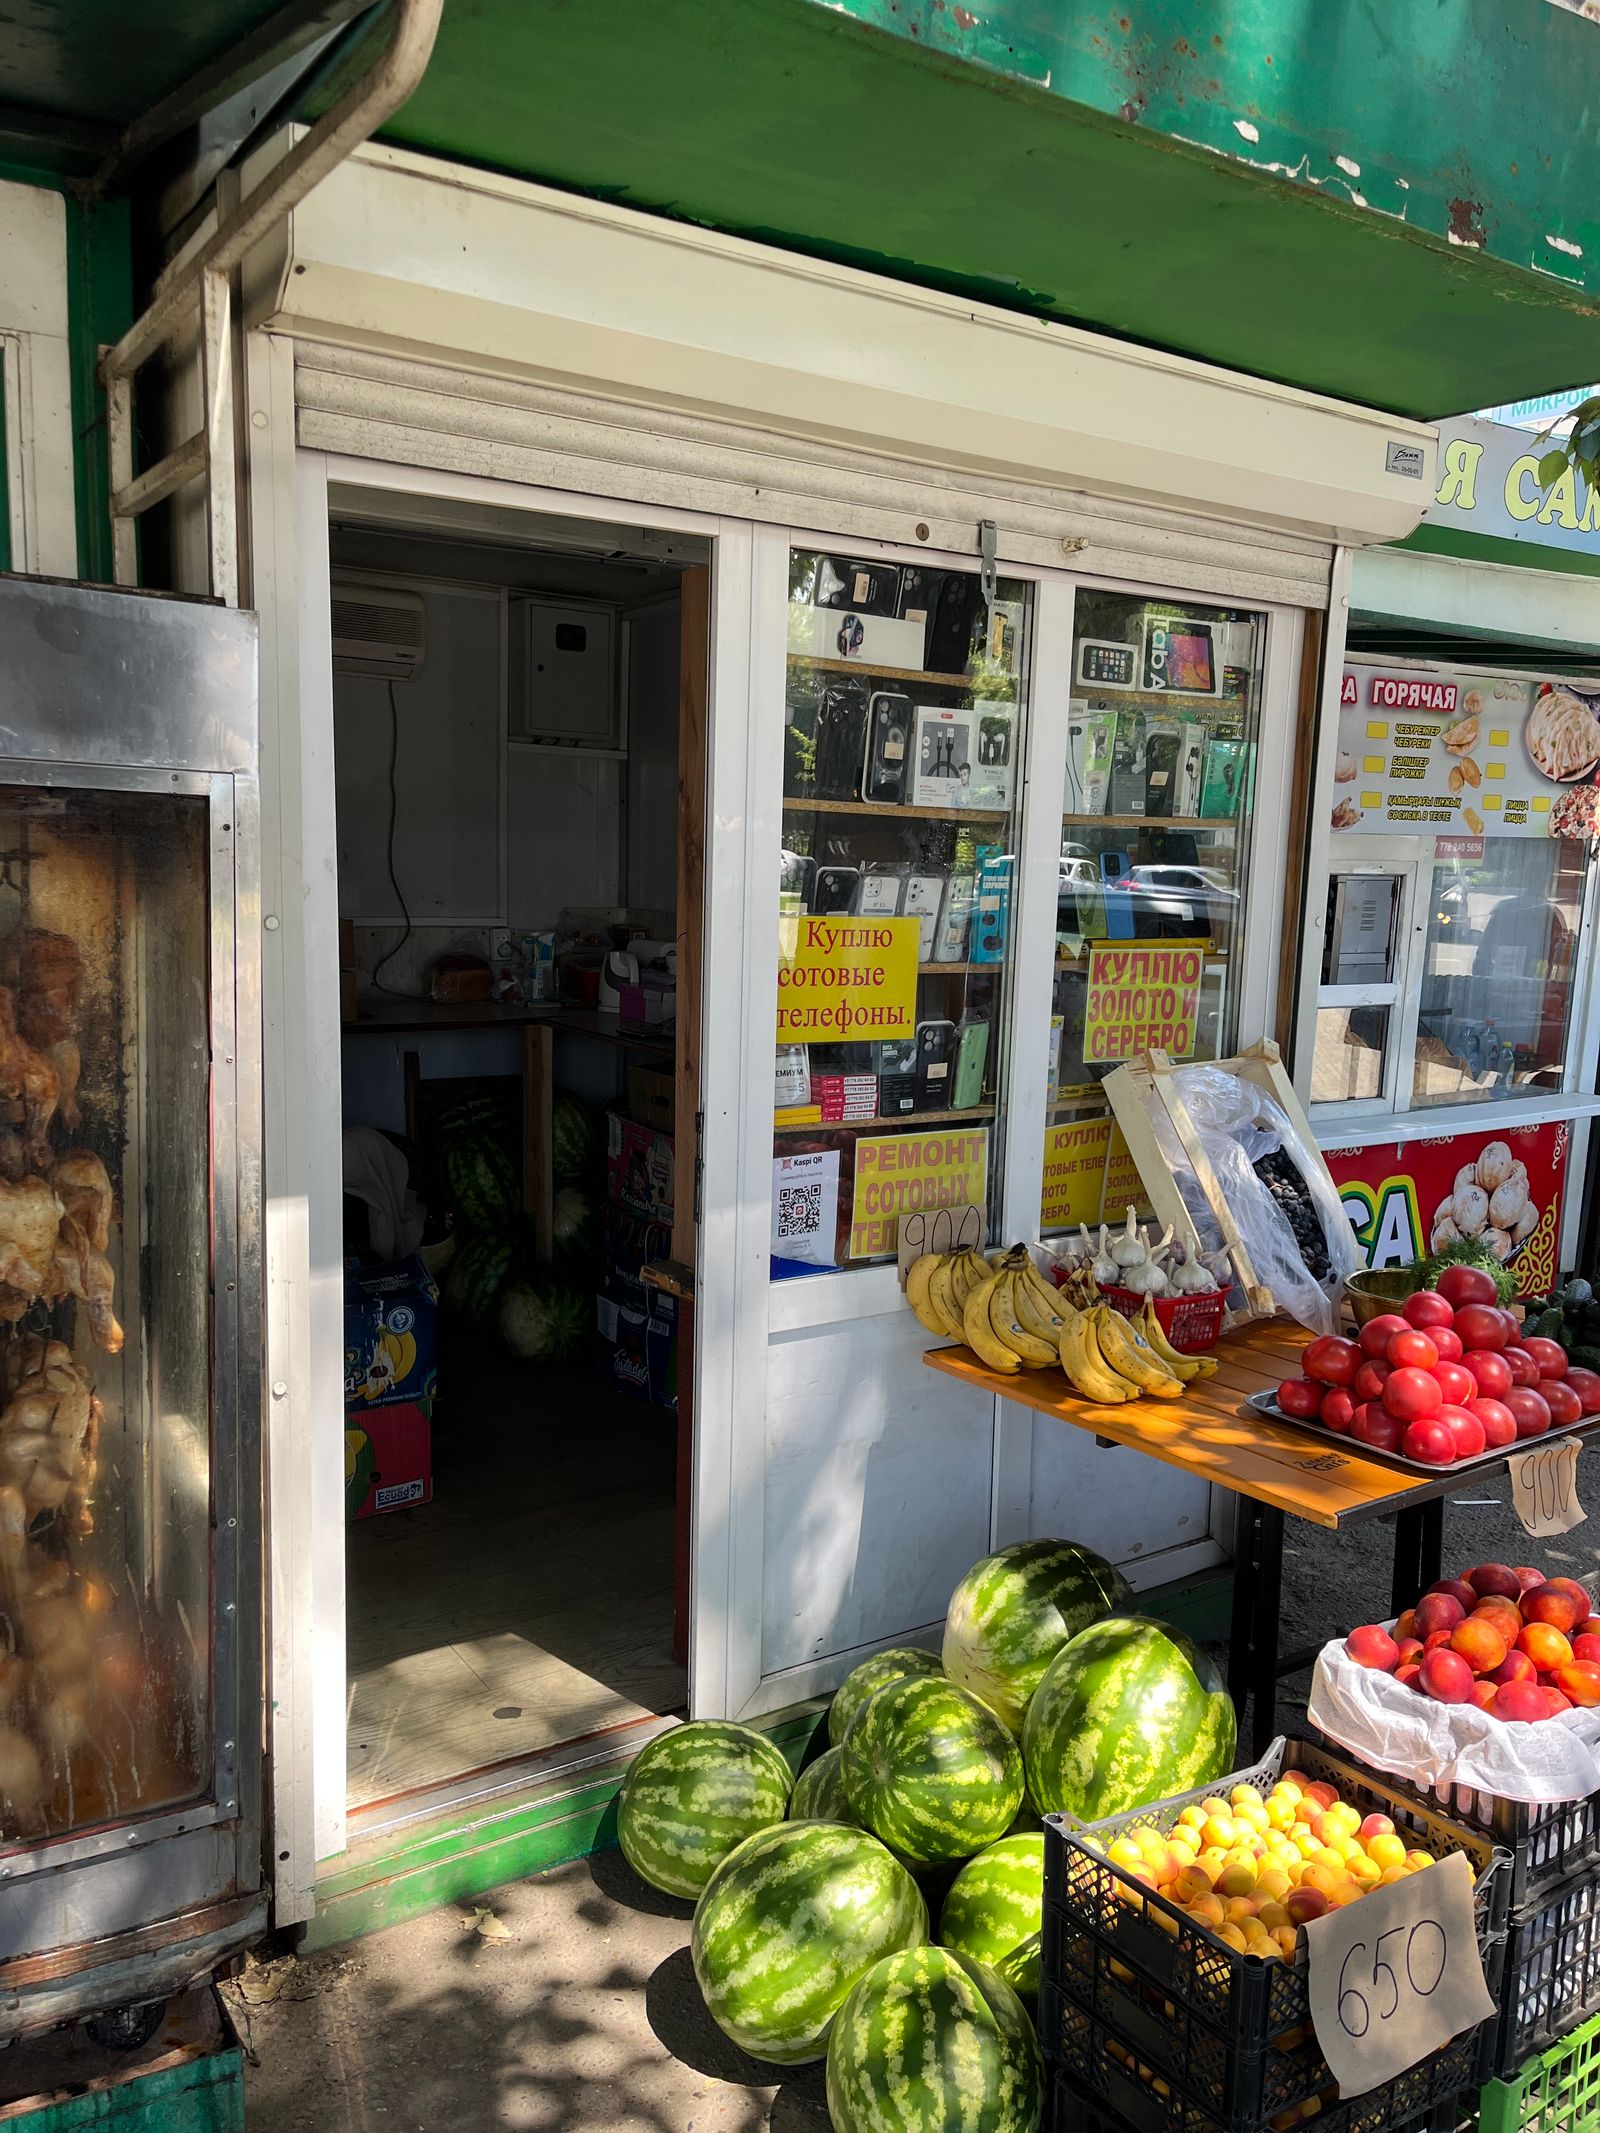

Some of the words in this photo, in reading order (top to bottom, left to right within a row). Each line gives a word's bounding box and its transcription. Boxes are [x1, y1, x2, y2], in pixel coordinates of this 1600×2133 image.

[1436, 439, 1485, 510] Я
[1151, 620, 1169, 670] Tab
[1340, 677, 1357, 702] А
[1372, 680, 1457, 711] ГОРЯЧАЯ
[1394, 737, 1432, 749] ЧЕБУРЕКИ
[1389, 767, 1426, 779] ПИРОЖКИ
[1387, 810, 1421, 821] СОСИСКА
[1422, 811, 1428, 821] В
[1429, 811, 1451, 822] ТЕСТЕ
[1503, 813, 1528, 824] ПИЦЦА
[1505, 800, 1529, 811] ПИЦЦА
[806, 921, 893, 955] Куплю
[778, 967, 885, 988] сотовые
[1093, 952, 1200, 985] КУПЛЮ
[777, 999, 911, 1034] телефоны.
[1088, 989, 1176, 1023] ЗОЛОТО
[1181, 988, 1197, 1020] И
[1091, 1023, 1188, 1059] СЕРЕБРО
[798, 1082, 805, 1092] 5
[1054, 1125, 1111, 1150] КУПЛЮ
[794, 1157, 812, 1168] Kaspi
[813, 1156, 823, 1164] QR
[857, 1137, 985, 1173] РЕМОНТ
[1080, 1156, 1106, 1171] ТЕЛЕ
[865, 1173, 970, 1216] СОТОВЫХ
[853, 1219, 896, 1254] ТЕЛ
[905, 1205, 981, 1256] 900
[1521, 1444, 1574, 1530] 900
[1337, 1919, 1447, 2038] 650
